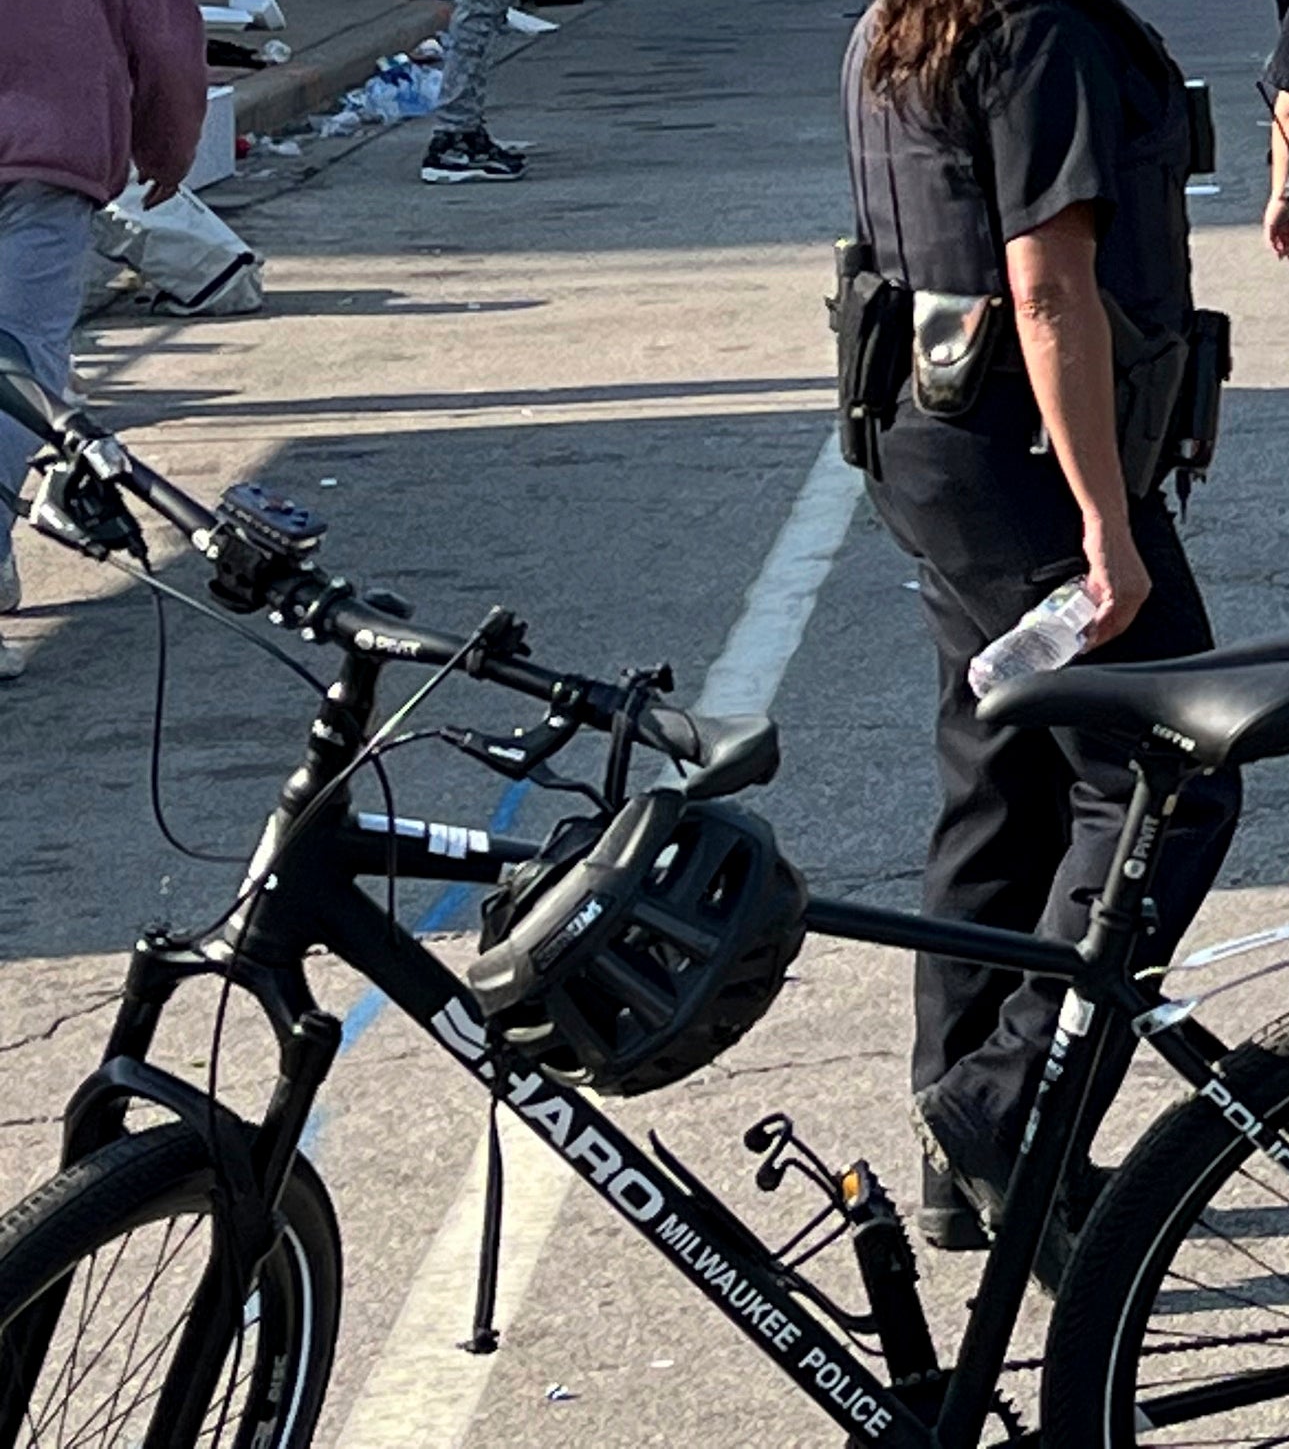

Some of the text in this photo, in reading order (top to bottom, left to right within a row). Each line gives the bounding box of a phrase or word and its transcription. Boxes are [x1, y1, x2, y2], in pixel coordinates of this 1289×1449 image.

[480, 1063, 665, 1223] HARO
[655, 1213, 893, 1438] MILWAUKEE POLICE
